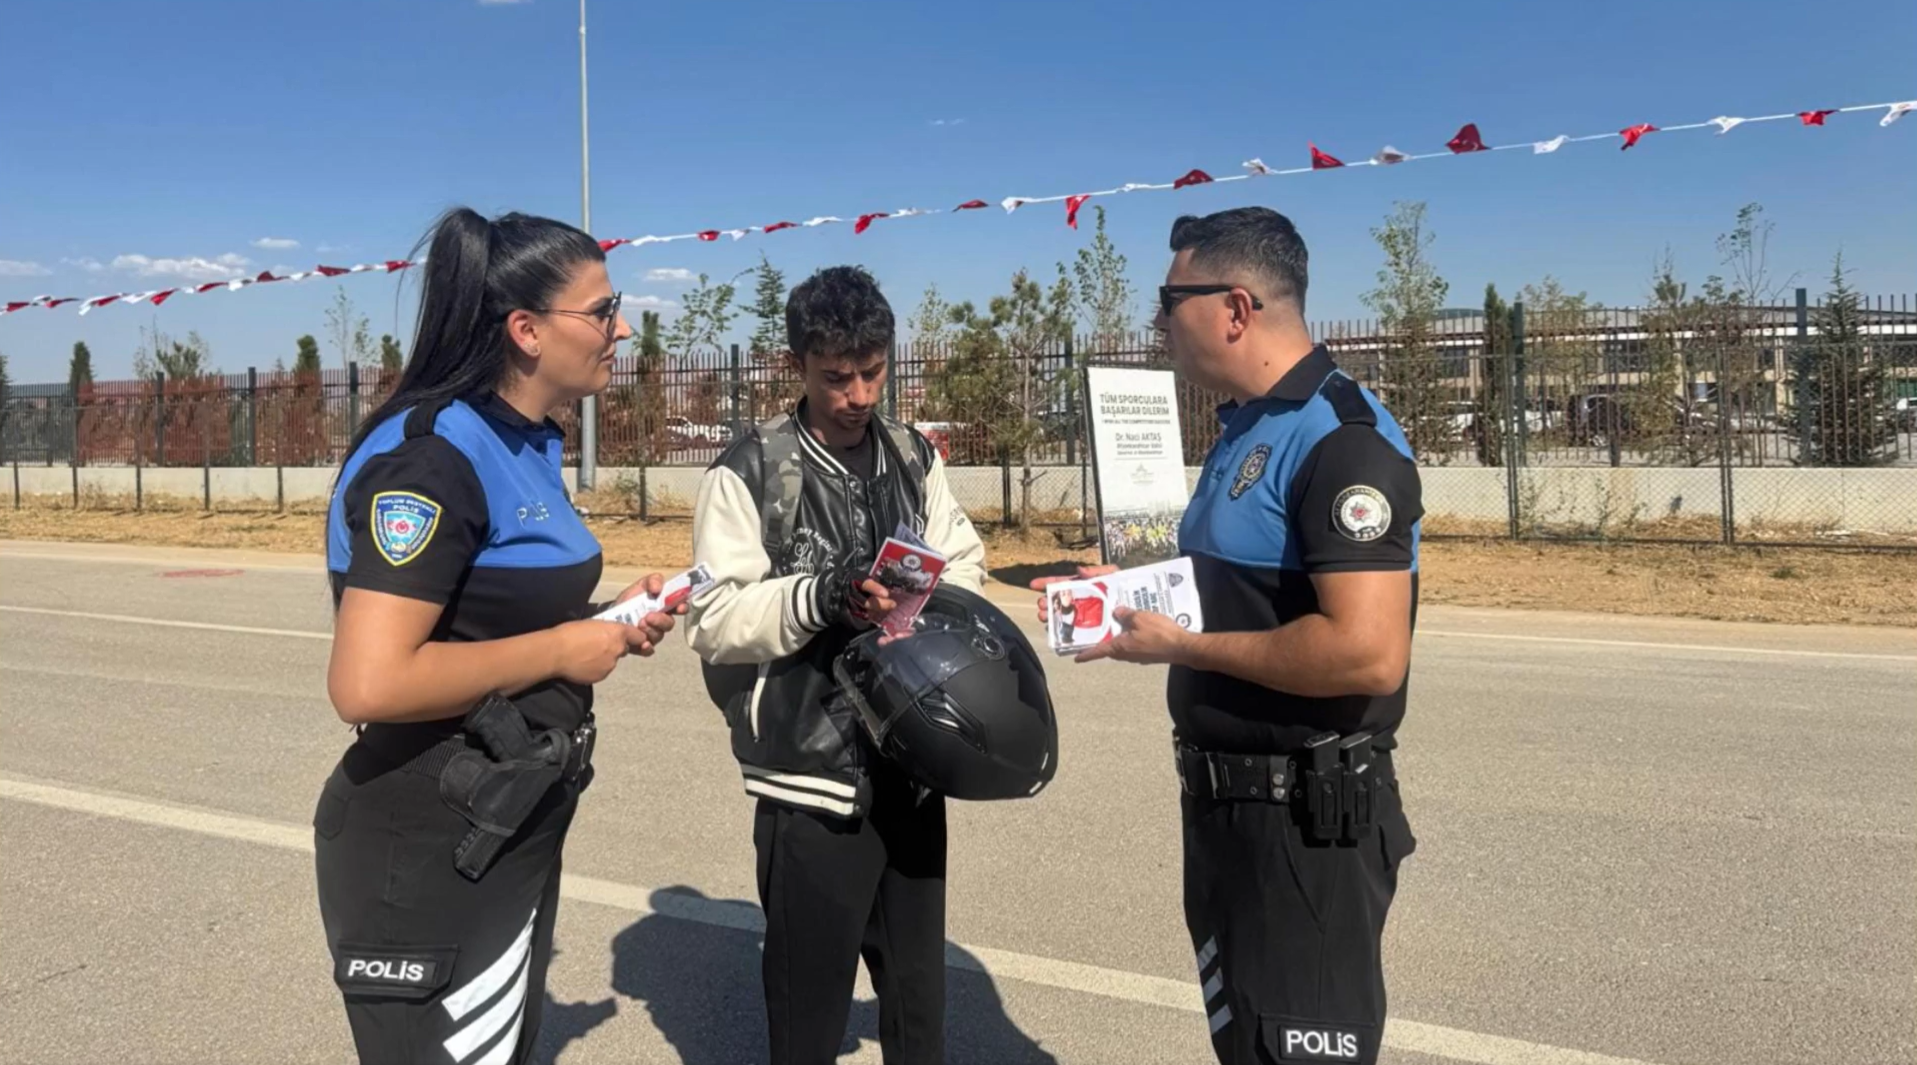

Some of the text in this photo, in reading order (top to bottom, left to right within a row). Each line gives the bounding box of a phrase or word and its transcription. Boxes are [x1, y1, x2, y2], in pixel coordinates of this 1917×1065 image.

[1099, 392, 1168, 405] TÜM SPORCULARA
[1100, 405, 1141, 418] BAŞARILAR
[1115, 432, 1162, 442] Dr. Naci AKTAŞ
[348, 959, 424, 982] POLİS
[1286, 1030, 1358, 1057] POLİS
